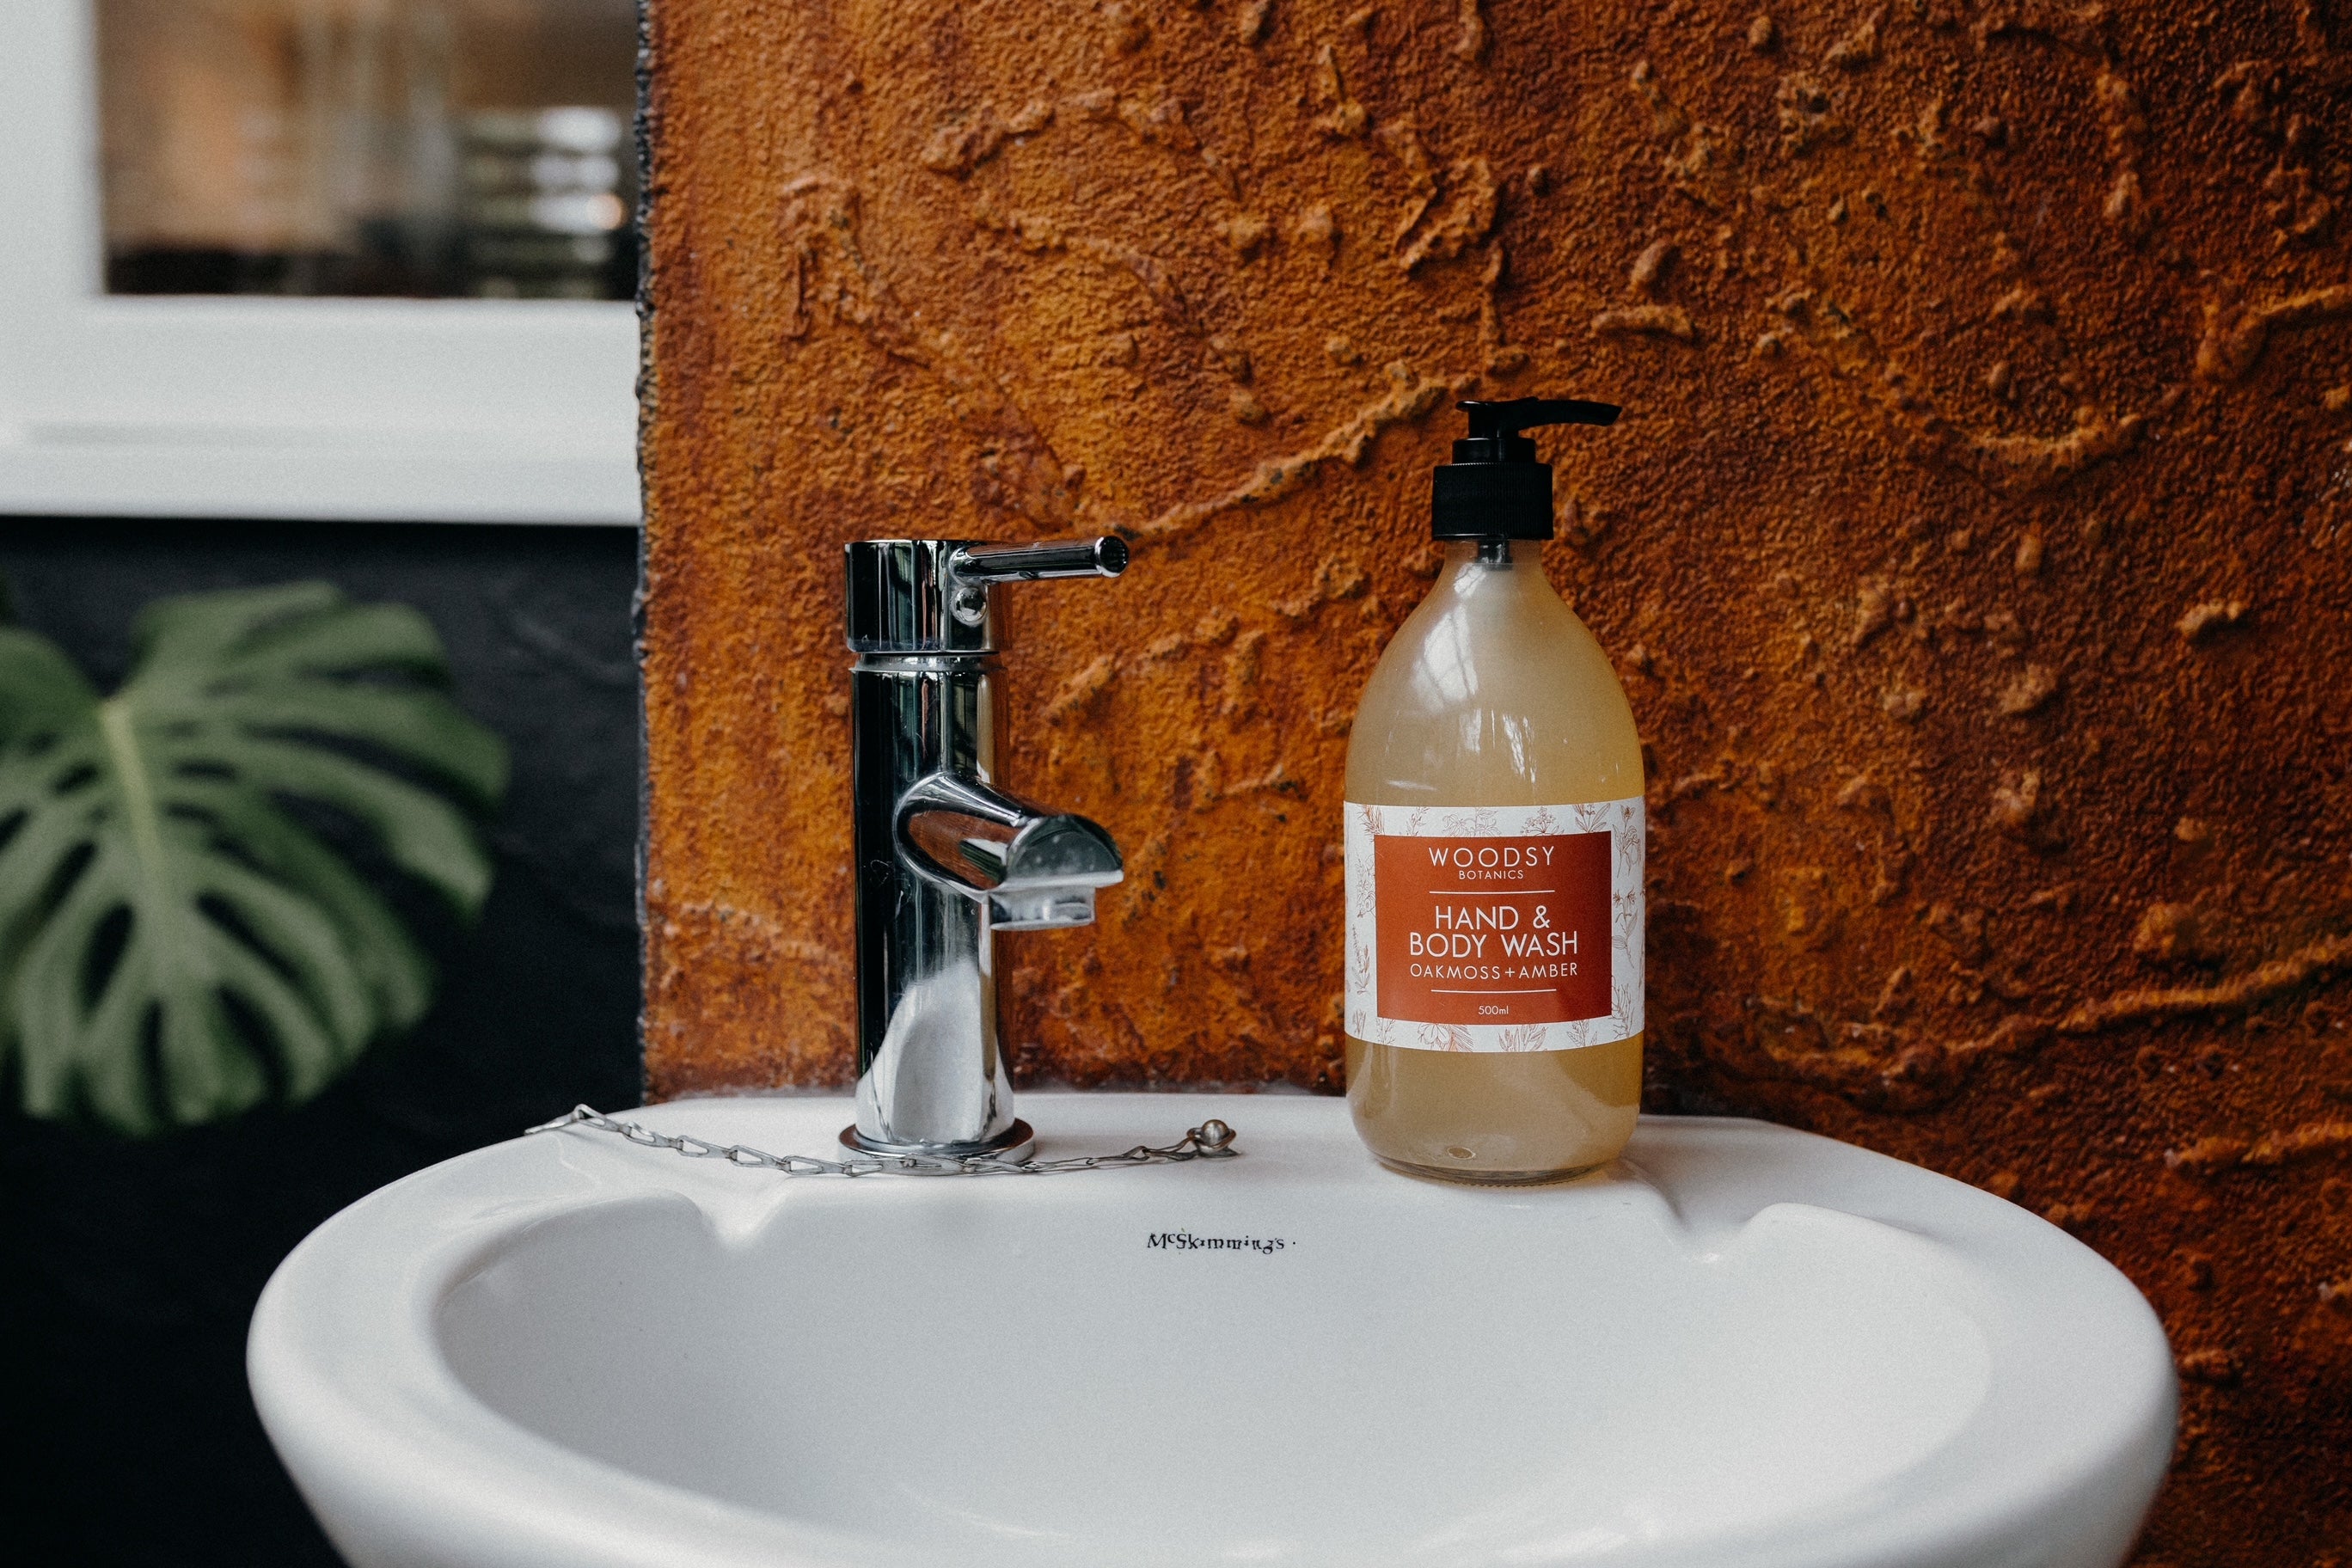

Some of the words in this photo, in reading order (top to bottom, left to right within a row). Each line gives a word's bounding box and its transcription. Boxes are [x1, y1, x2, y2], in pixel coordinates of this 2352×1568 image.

[1429, 846, 1554, 867] WOODSY
[1459, 870, 1523, 879] BOTANICS
[1436, 906, 1518, 930] HAND
[1533, 905, 1550, 928] &
[1410, 932, 1486, 958] BODY
[1501, 931, 1577, 958] WASH
[1479, 1005, 1509, 1015] 500ml
